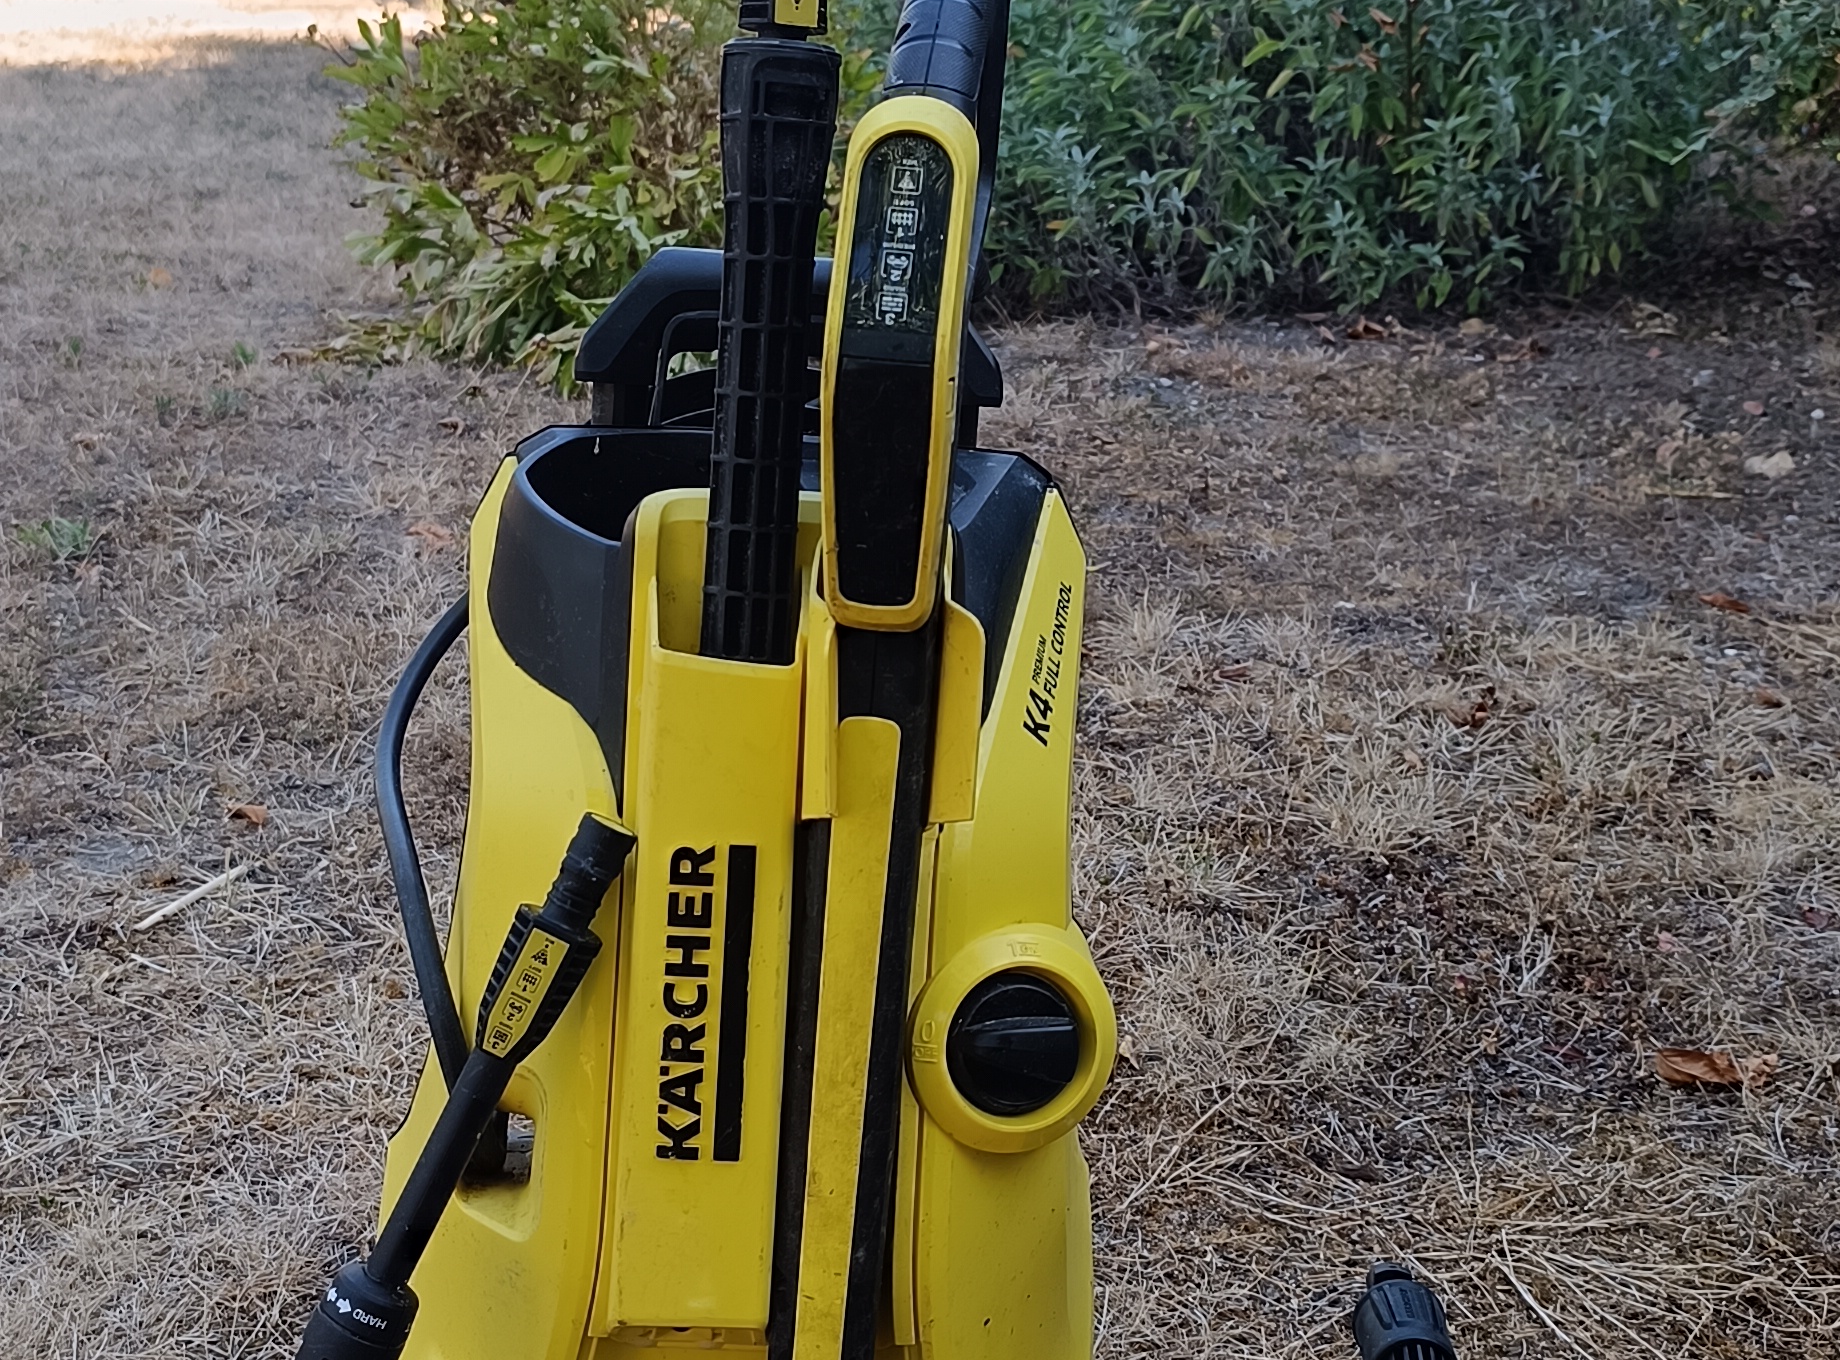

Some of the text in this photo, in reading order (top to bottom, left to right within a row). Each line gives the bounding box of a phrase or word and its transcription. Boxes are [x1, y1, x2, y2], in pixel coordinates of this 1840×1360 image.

[890, 269, 902, 281] 2
[885, 313, 896, 325] 3
[1043, 581, 1072, 700] FULL CONTROL
[1032, 634, 1047, 685] PREMIUM
[655, 844, 716, 1161] KÄRCHER
[507, 1012, 515, 1021] 2
[352, 1308, 388, 1330] HARD
